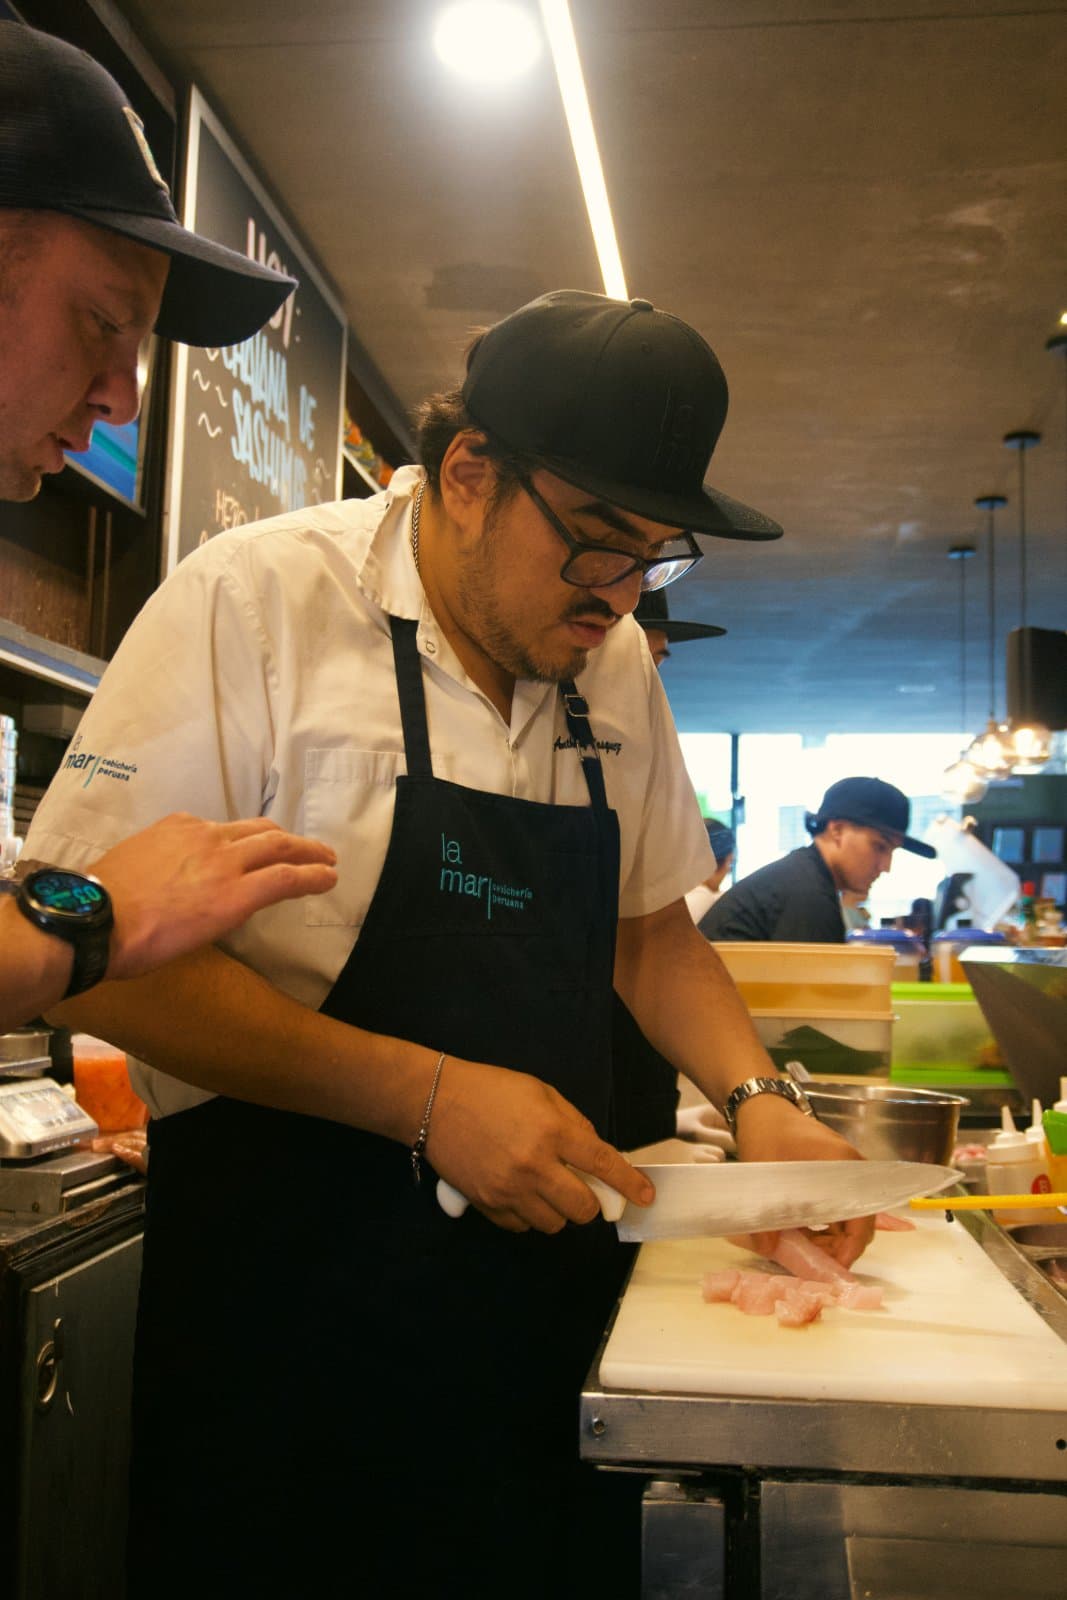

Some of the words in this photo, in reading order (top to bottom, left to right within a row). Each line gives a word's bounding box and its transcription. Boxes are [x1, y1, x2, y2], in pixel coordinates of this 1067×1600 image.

[96, 767, 131, 782] peruana
[440, 832, 463, 864] la
[439, 867, 489, 898] mar
[491, 894, 525, 911] peruana
